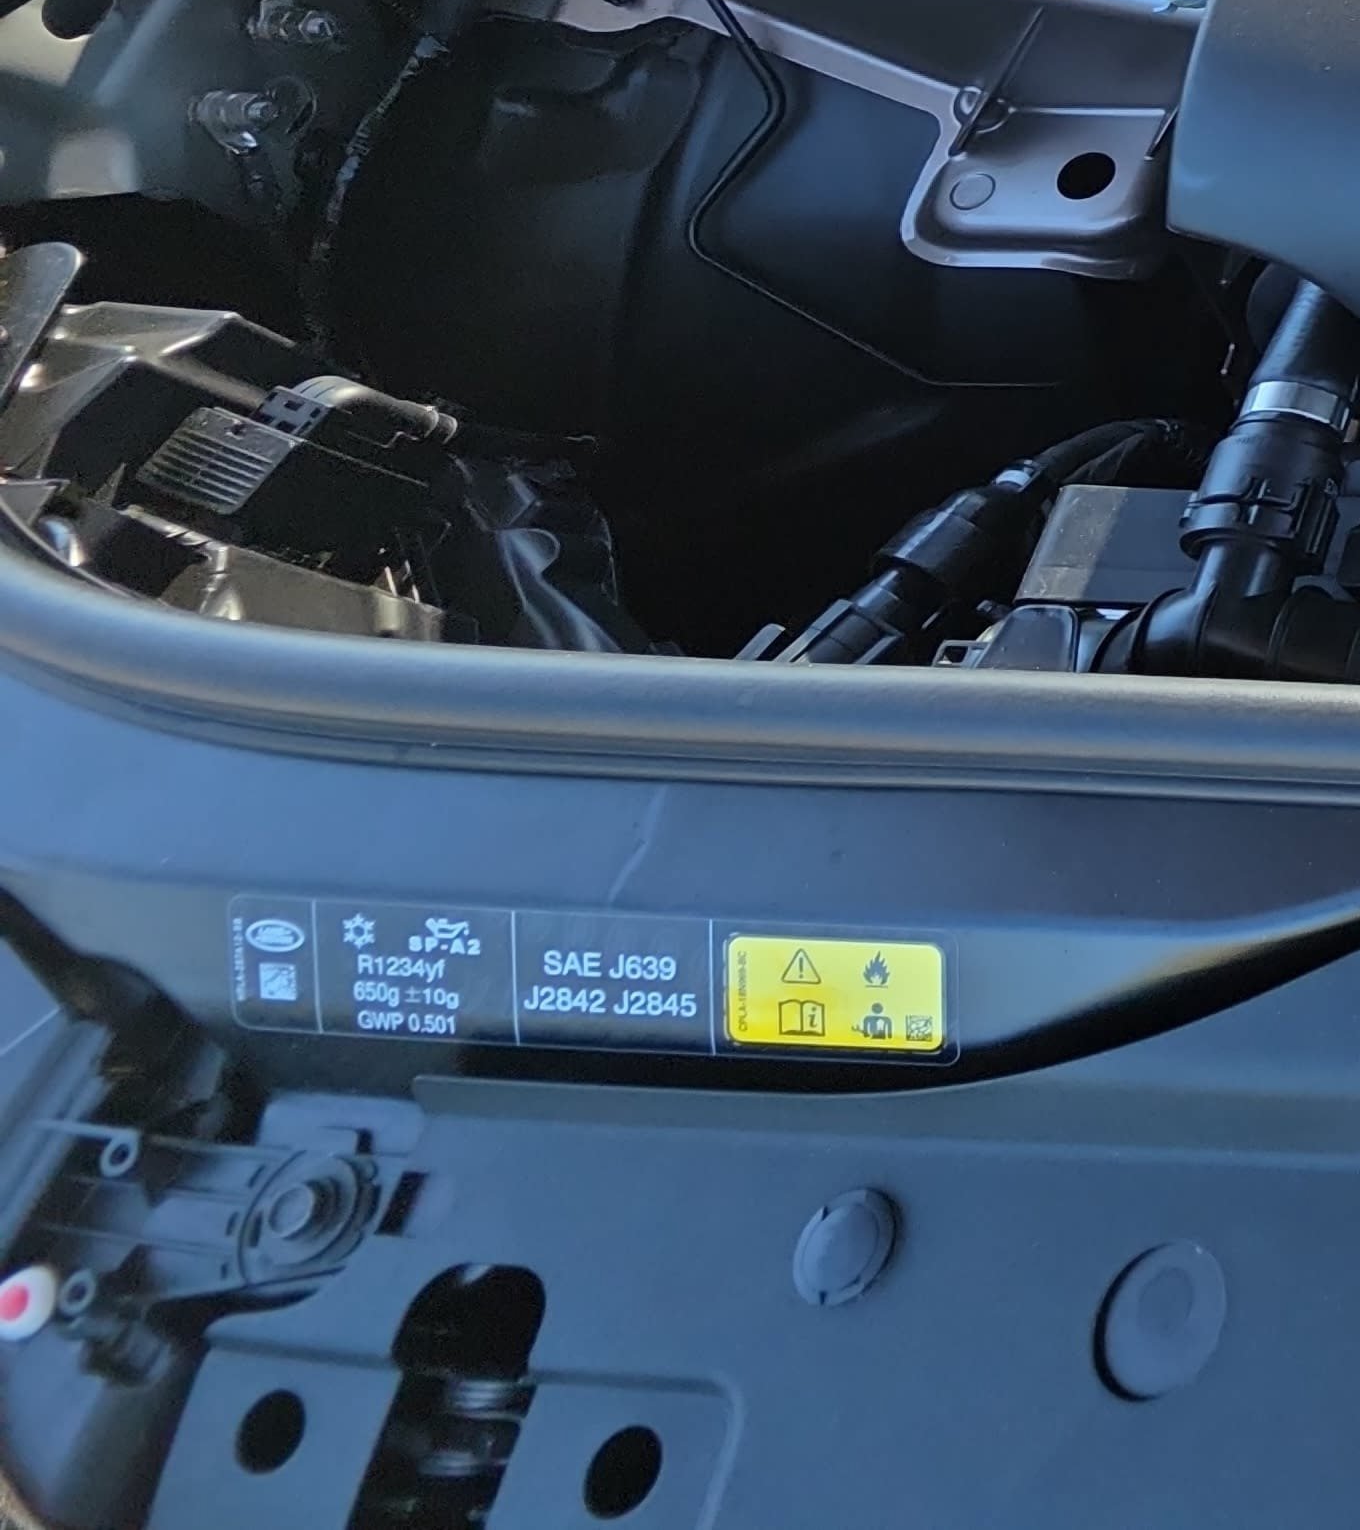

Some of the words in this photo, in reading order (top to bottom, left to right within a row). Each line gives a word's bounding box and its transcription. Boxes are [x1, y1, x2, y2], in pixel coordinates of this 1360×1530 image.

[408, 935, 481, 955] SP-A2
[357, 954, 446, 983] R1234yf
[543, 949, 602, 978] SAE
[608, 953, 677, 981] J639
[353, 981, 400, 1008] 650g
[523, 985, 607, 1013] J2842
[612, 989, 698, 1017] J2845
[357, 1010, 404, 1031] GWP
[407, 1013, 457, 1034] 0.501
